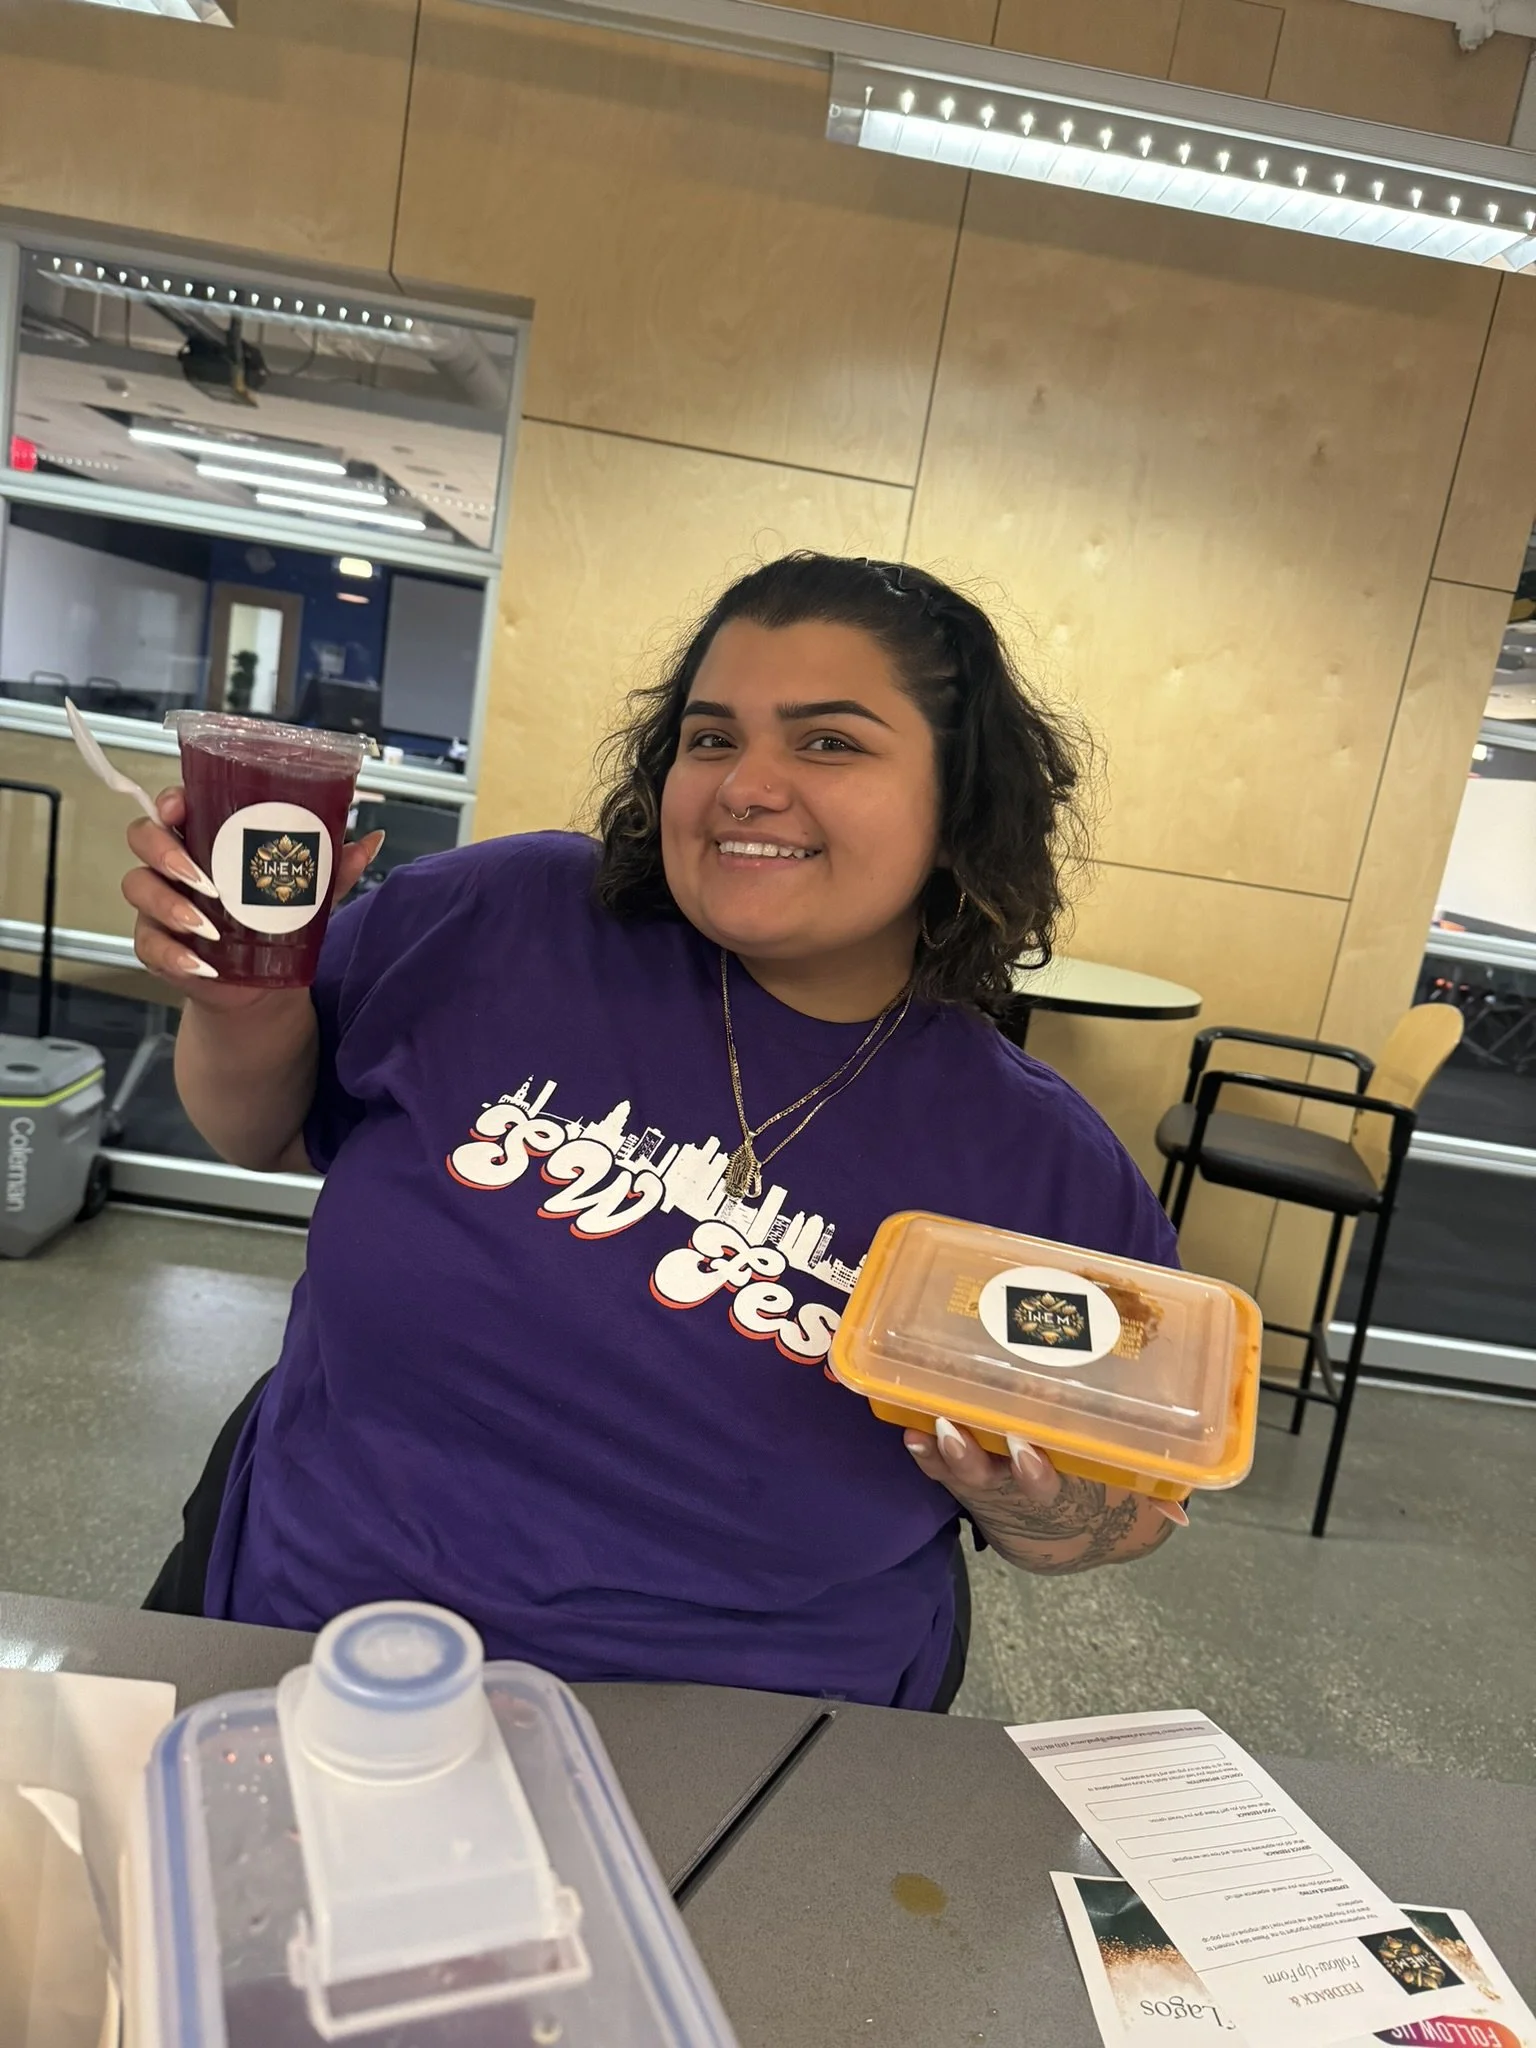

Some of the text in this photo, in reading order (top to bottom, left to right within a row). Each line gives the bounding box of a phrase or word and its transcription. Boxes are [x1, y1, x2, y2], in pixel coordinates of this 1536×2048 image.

[5, 1116, 36, 1212] Coleman
[649, 1219, 842, 1369] Fes
[1263, 1954, 1360, 1984] Follow-Up Form
[1288, 1981, 1365, 2007] FEEDBACK &
[1139, 1995, 1223, 2027] Lagos
[1419, 2019, 1503, 2048] FOLLOW
